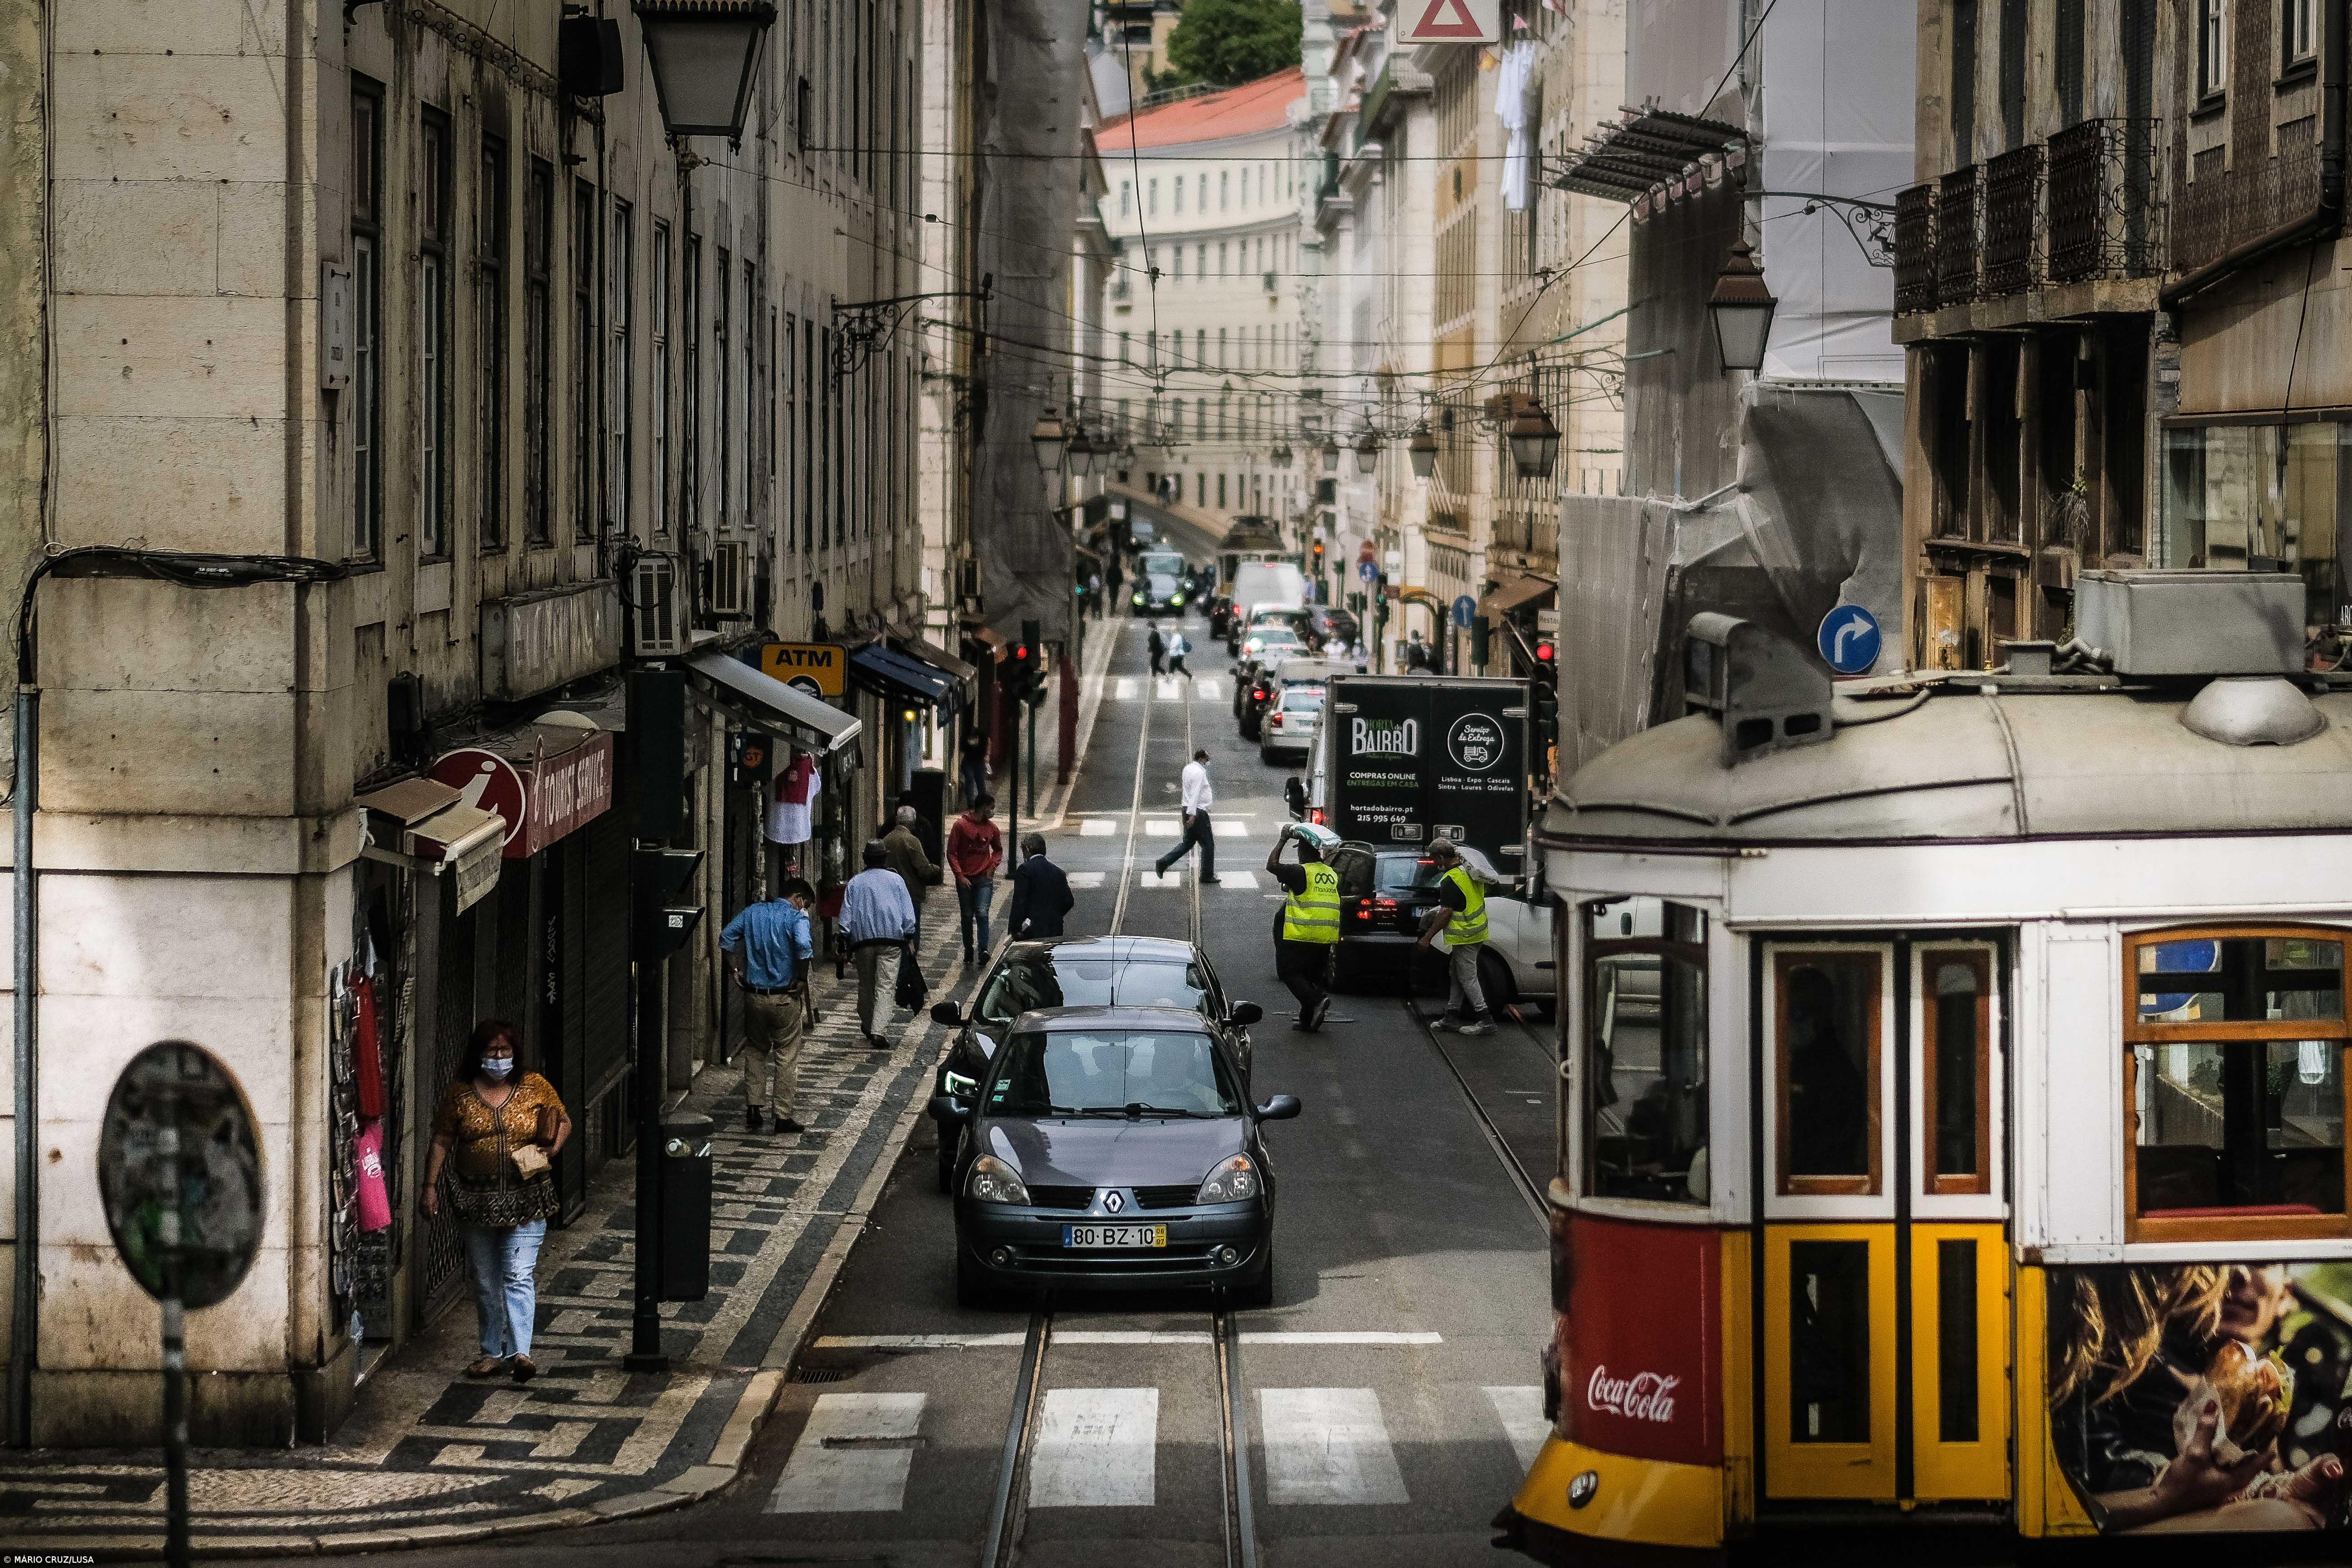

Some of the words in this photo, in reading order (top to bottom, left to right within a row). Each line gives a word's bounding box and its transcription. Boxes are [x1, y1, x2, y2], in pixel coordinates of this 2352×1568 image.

[775, 649, 832, 667] ATM
[1464, 725, 1490, 734] Serviço
[1352, 717, 1417, 755] BAIRRO
[1458, 733, 1467, 741] de
[1467, 733, 1495, 745] Entrega
[1351, 804, 1413, 814] hortadobairro.pt
[1390, 815, 1406, 823] 649
